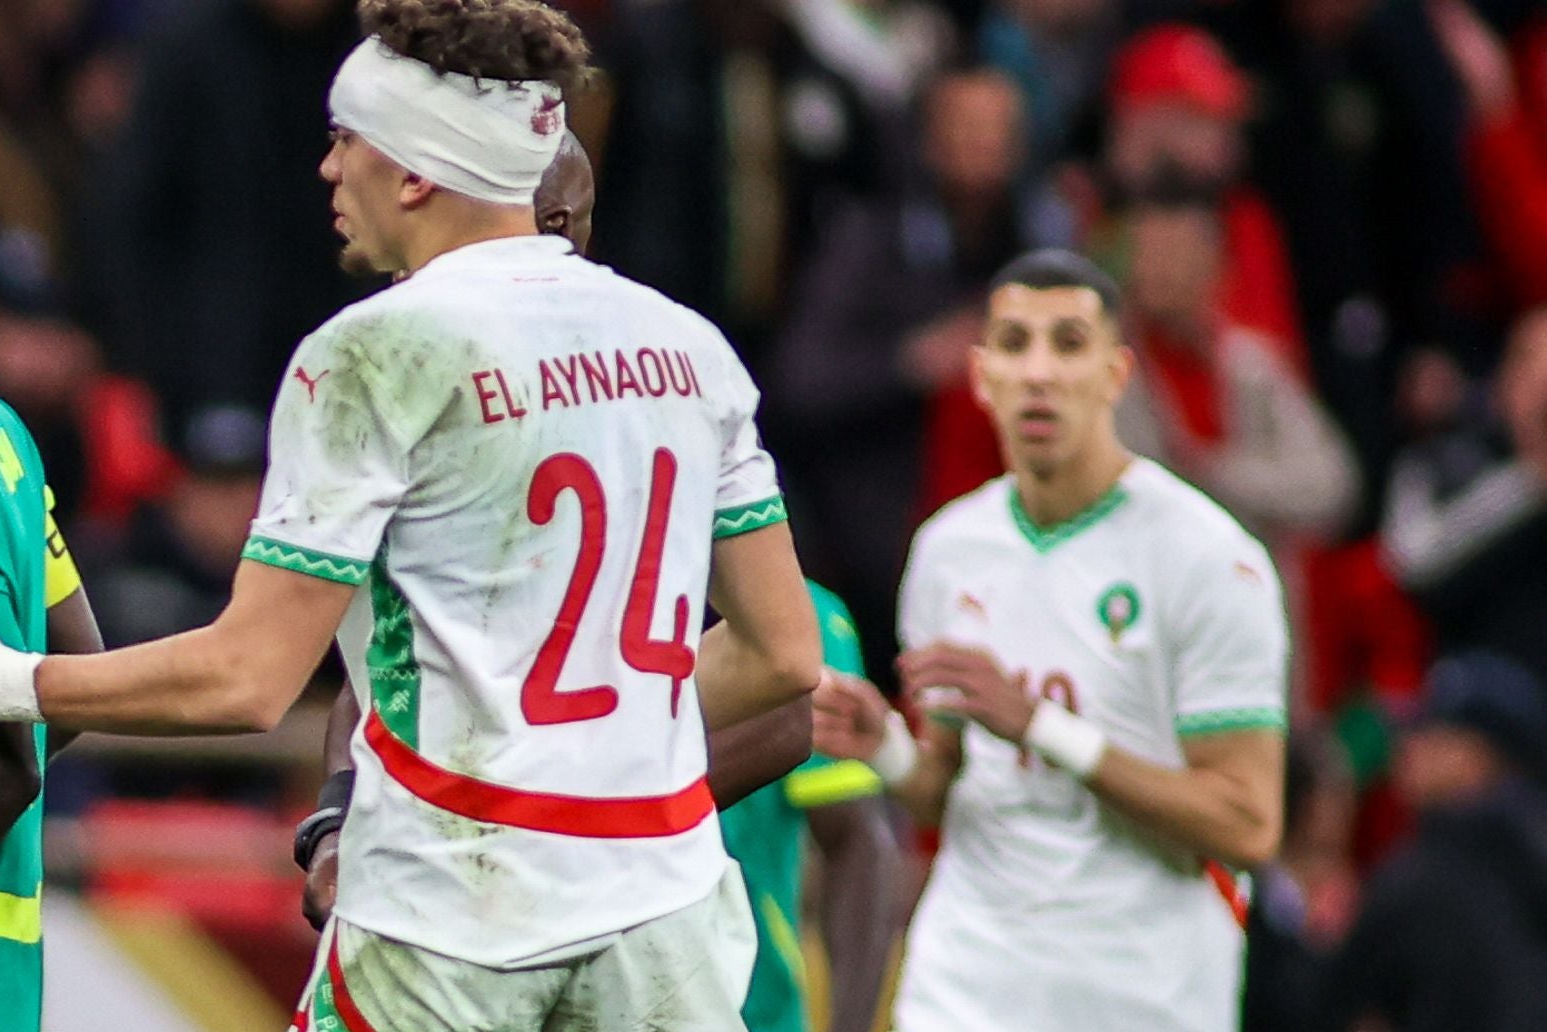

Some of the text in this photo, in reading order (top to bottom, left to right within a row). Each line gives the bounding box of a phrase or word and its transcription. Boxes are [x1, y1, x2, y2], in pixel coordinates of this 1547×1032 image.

[471, 346, 702, 425] EL AYNAOUI
[519, 445, 696, 728] 24
